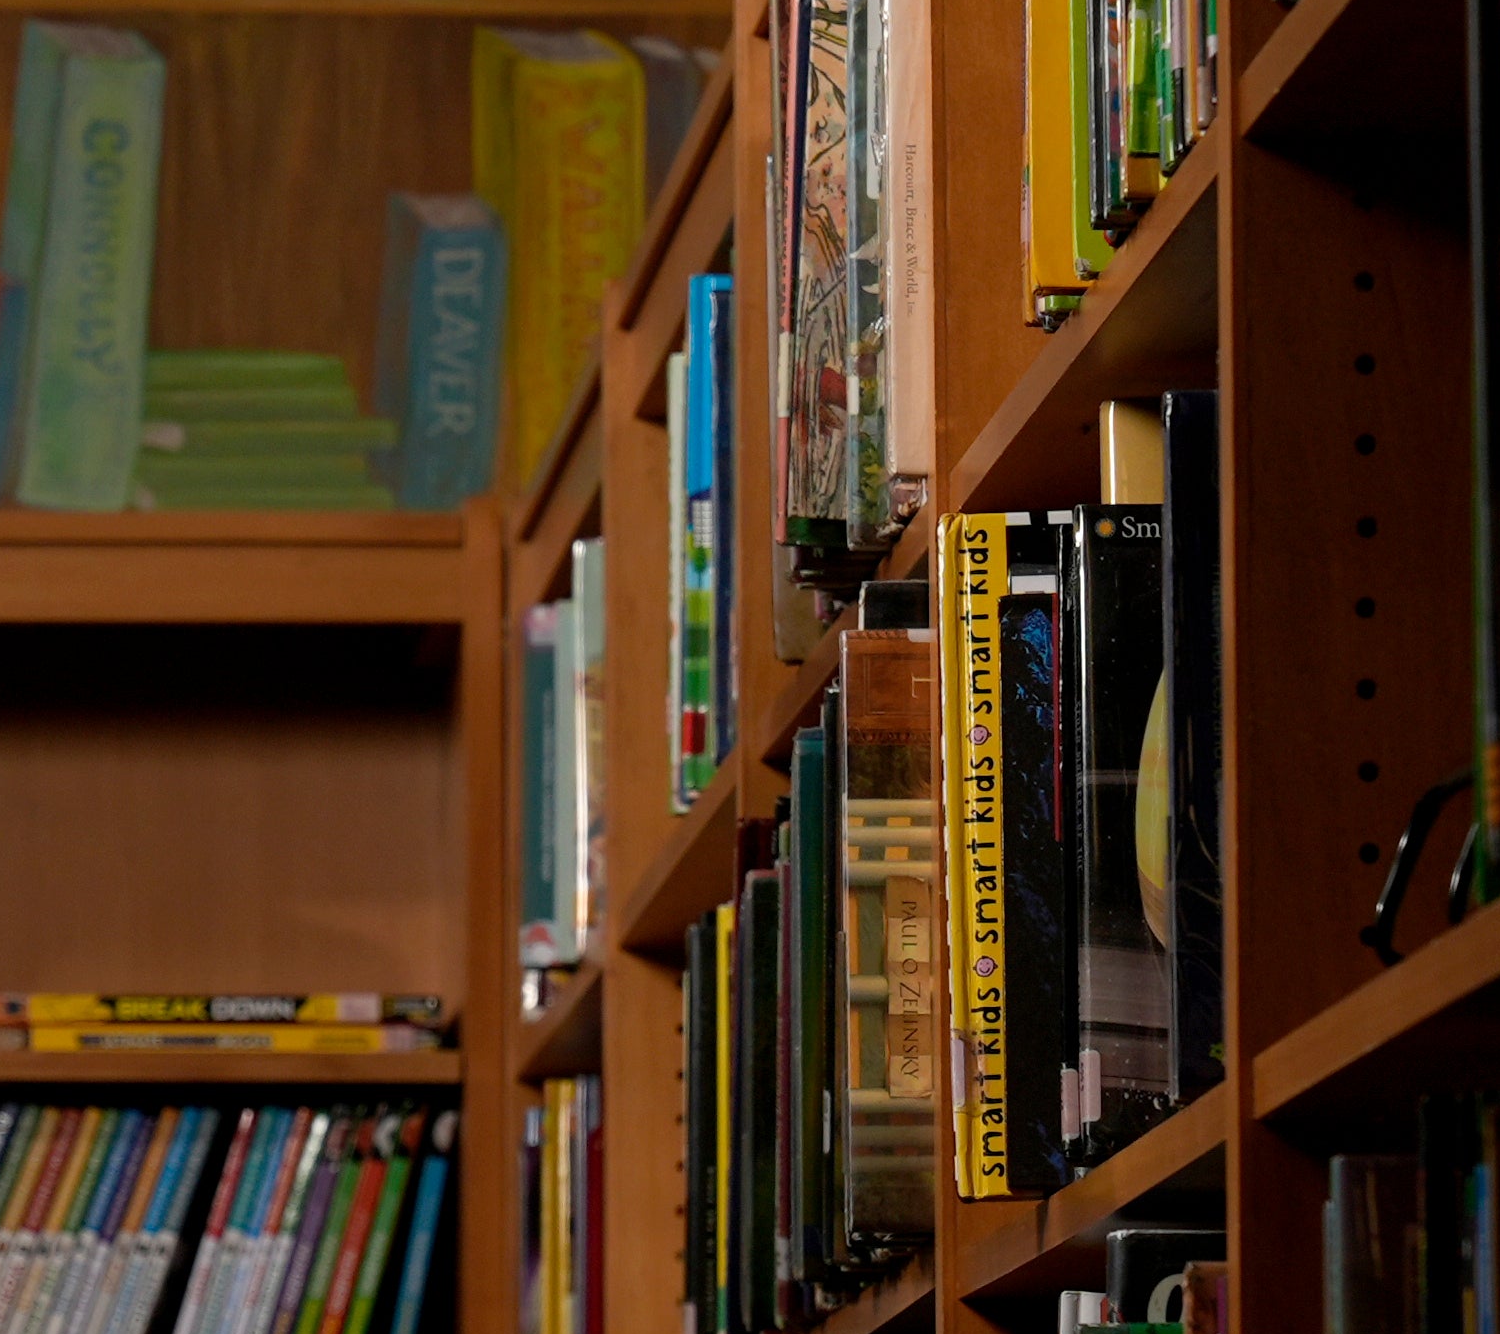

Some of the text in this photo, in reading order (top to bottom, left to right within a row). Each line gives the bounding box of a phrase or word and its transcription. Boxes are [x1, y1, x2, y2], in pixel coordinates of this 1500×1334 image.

[904, 143, 918, 203] Harcourt,
[70, 117, 132, 375] CONNOLLY
[904, 207, 918, 240] Brace
[904, 242, 917, 254] &
[904, 256, 919, 298] World,
[425, 243, 485, 440] DEAVER
[958, 527, 1005, 1177] smart kids smart kids smart kids
[901, 900, 919, 952] PAUL
[899, 982, 922, 1079] ZELINSKY
